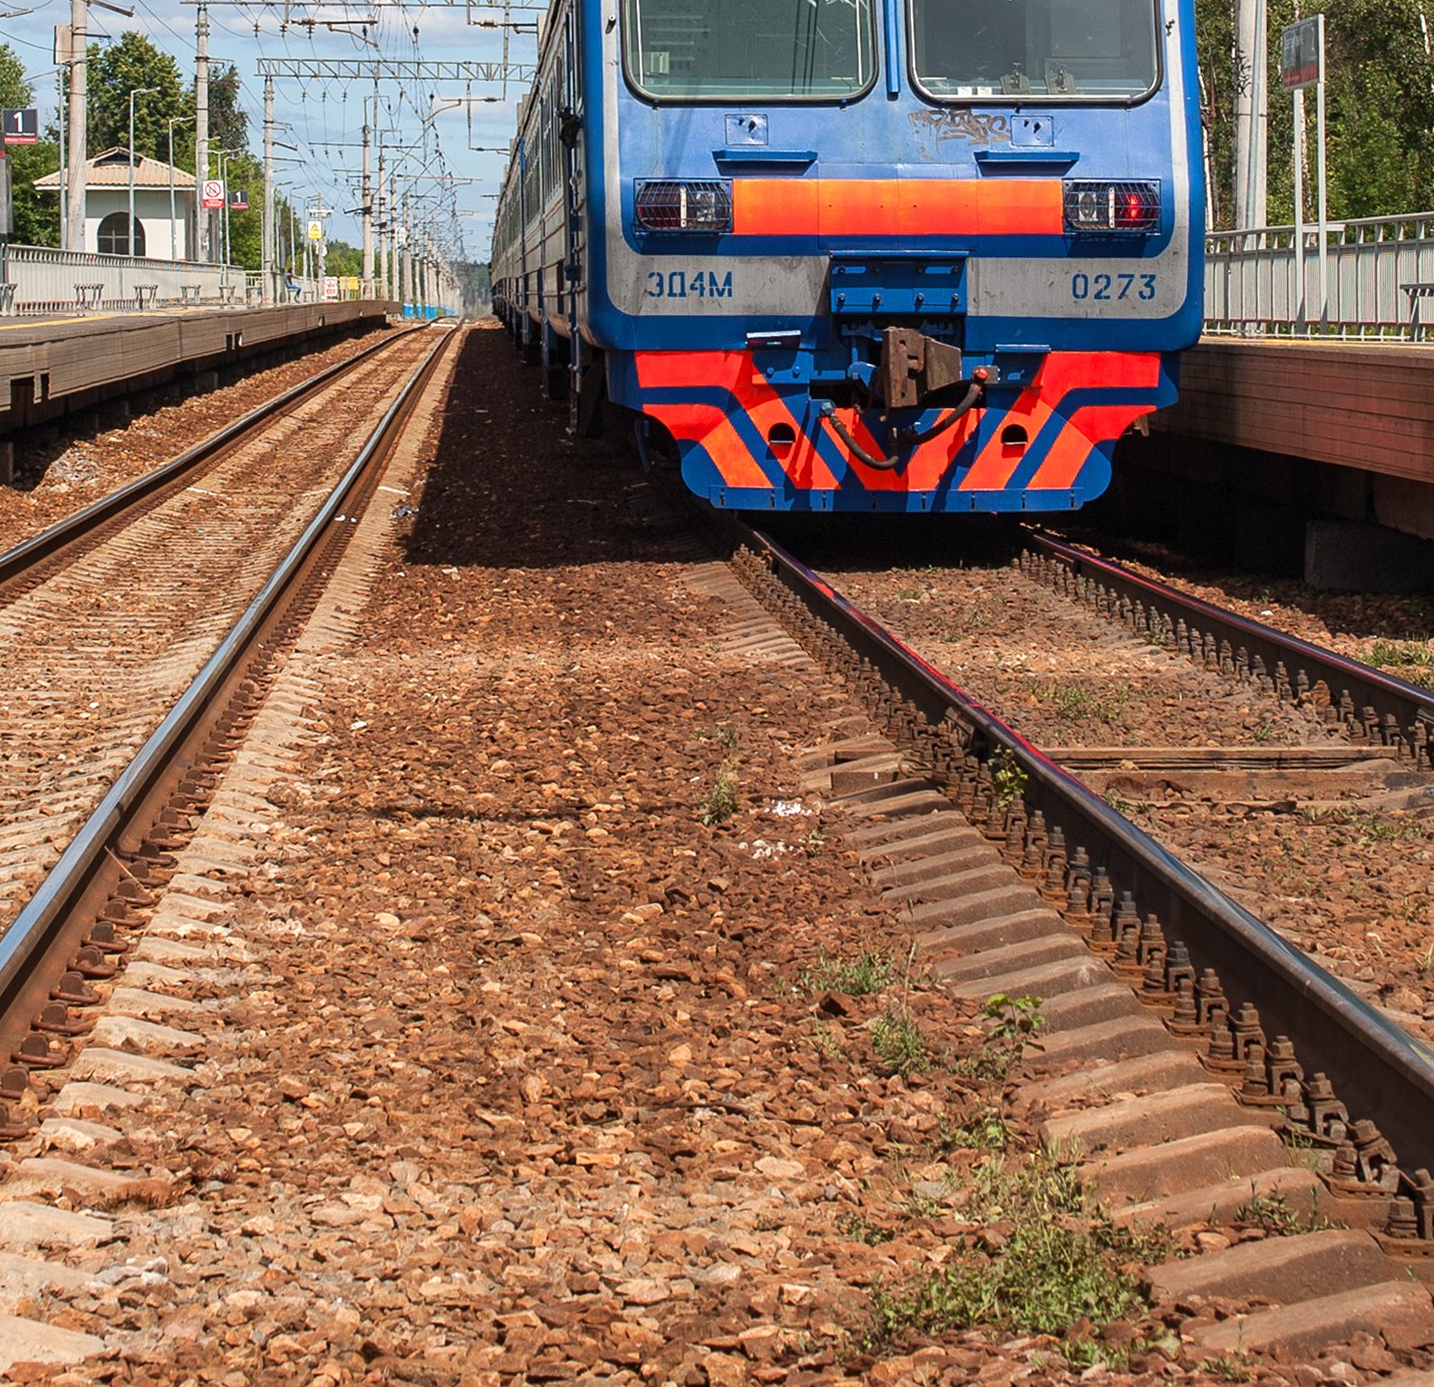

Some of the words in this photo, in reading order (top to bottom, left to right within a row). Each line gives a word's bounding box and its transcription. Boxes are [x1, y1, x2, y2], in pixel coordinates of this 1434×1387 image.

[13, 111, 23, 133] 1
[647, 271, 733, 298] ЭД4М
[1071, 274, 1157, 300] 0273
